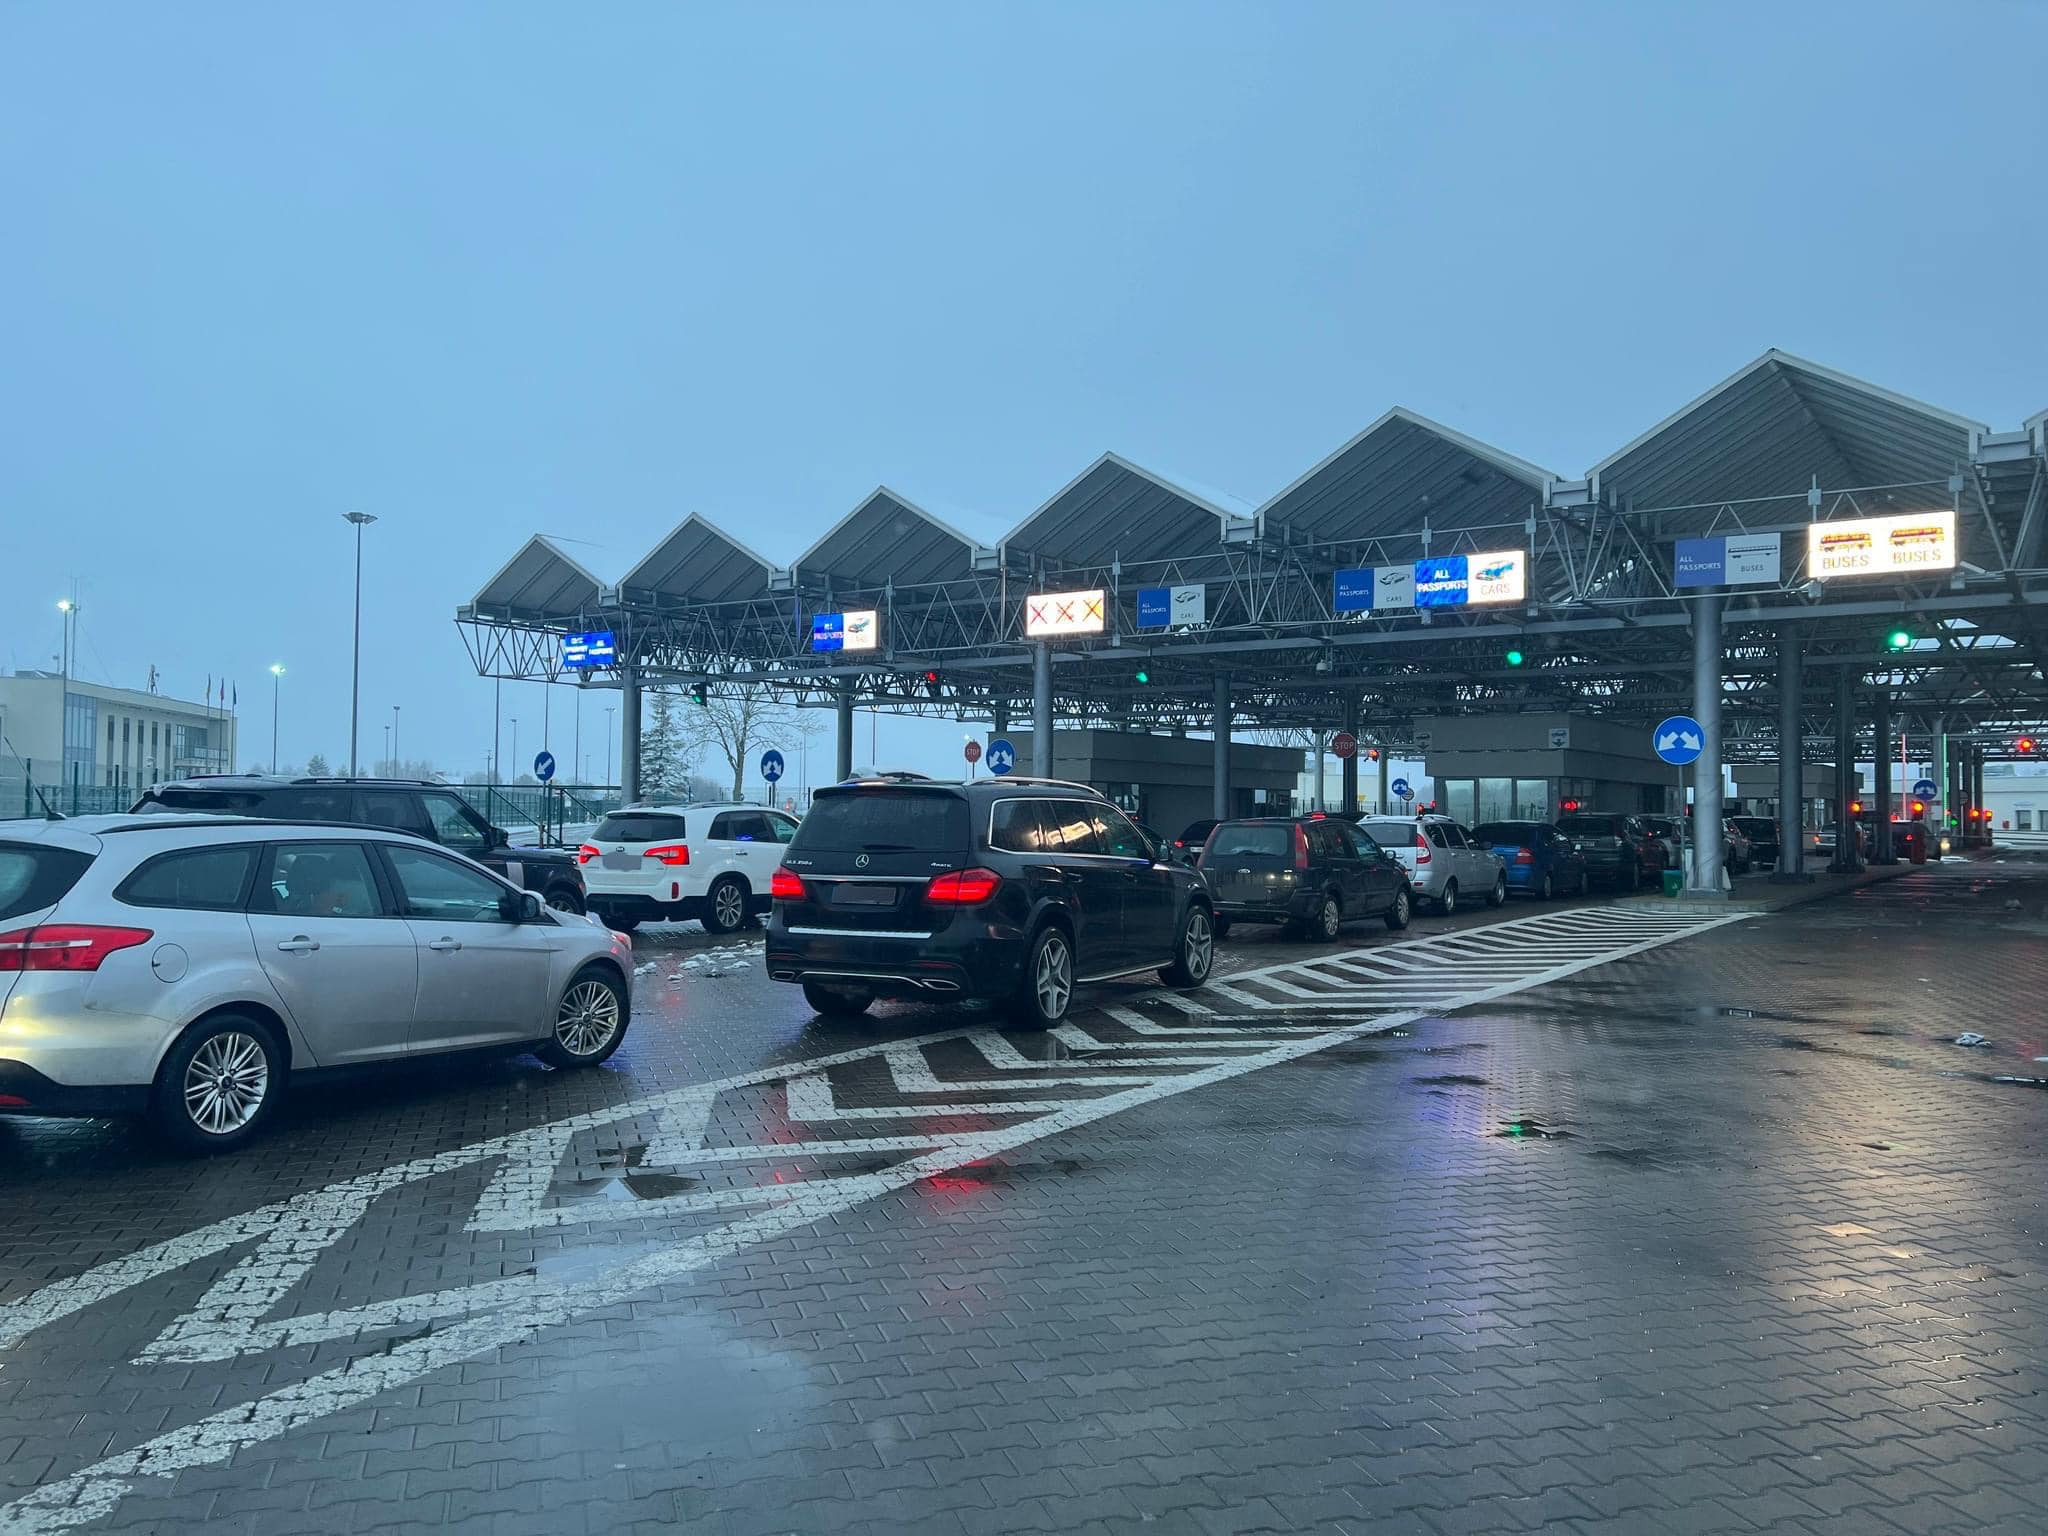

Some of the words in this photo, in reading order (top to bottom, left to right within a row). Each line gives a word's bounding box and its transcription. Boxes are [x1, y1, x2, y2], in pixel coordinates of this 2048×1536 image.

[1823, 555, 1869, 569] BUSES
[1892, 549, 1942, 564] BUSES
[1679, 562, 1721, 571] PASSPORTS
[1740, 564, 1765, 573] BUSES
[1434, 569, 1450, 580] ALL
[1416, 580, 1467, 592] PASSPORTS
[1481, 584, 1511, 596] CARS
[1339, 589, 1369, 597] PASSPORTS
[1335, 742, 1353, 750] STOP
